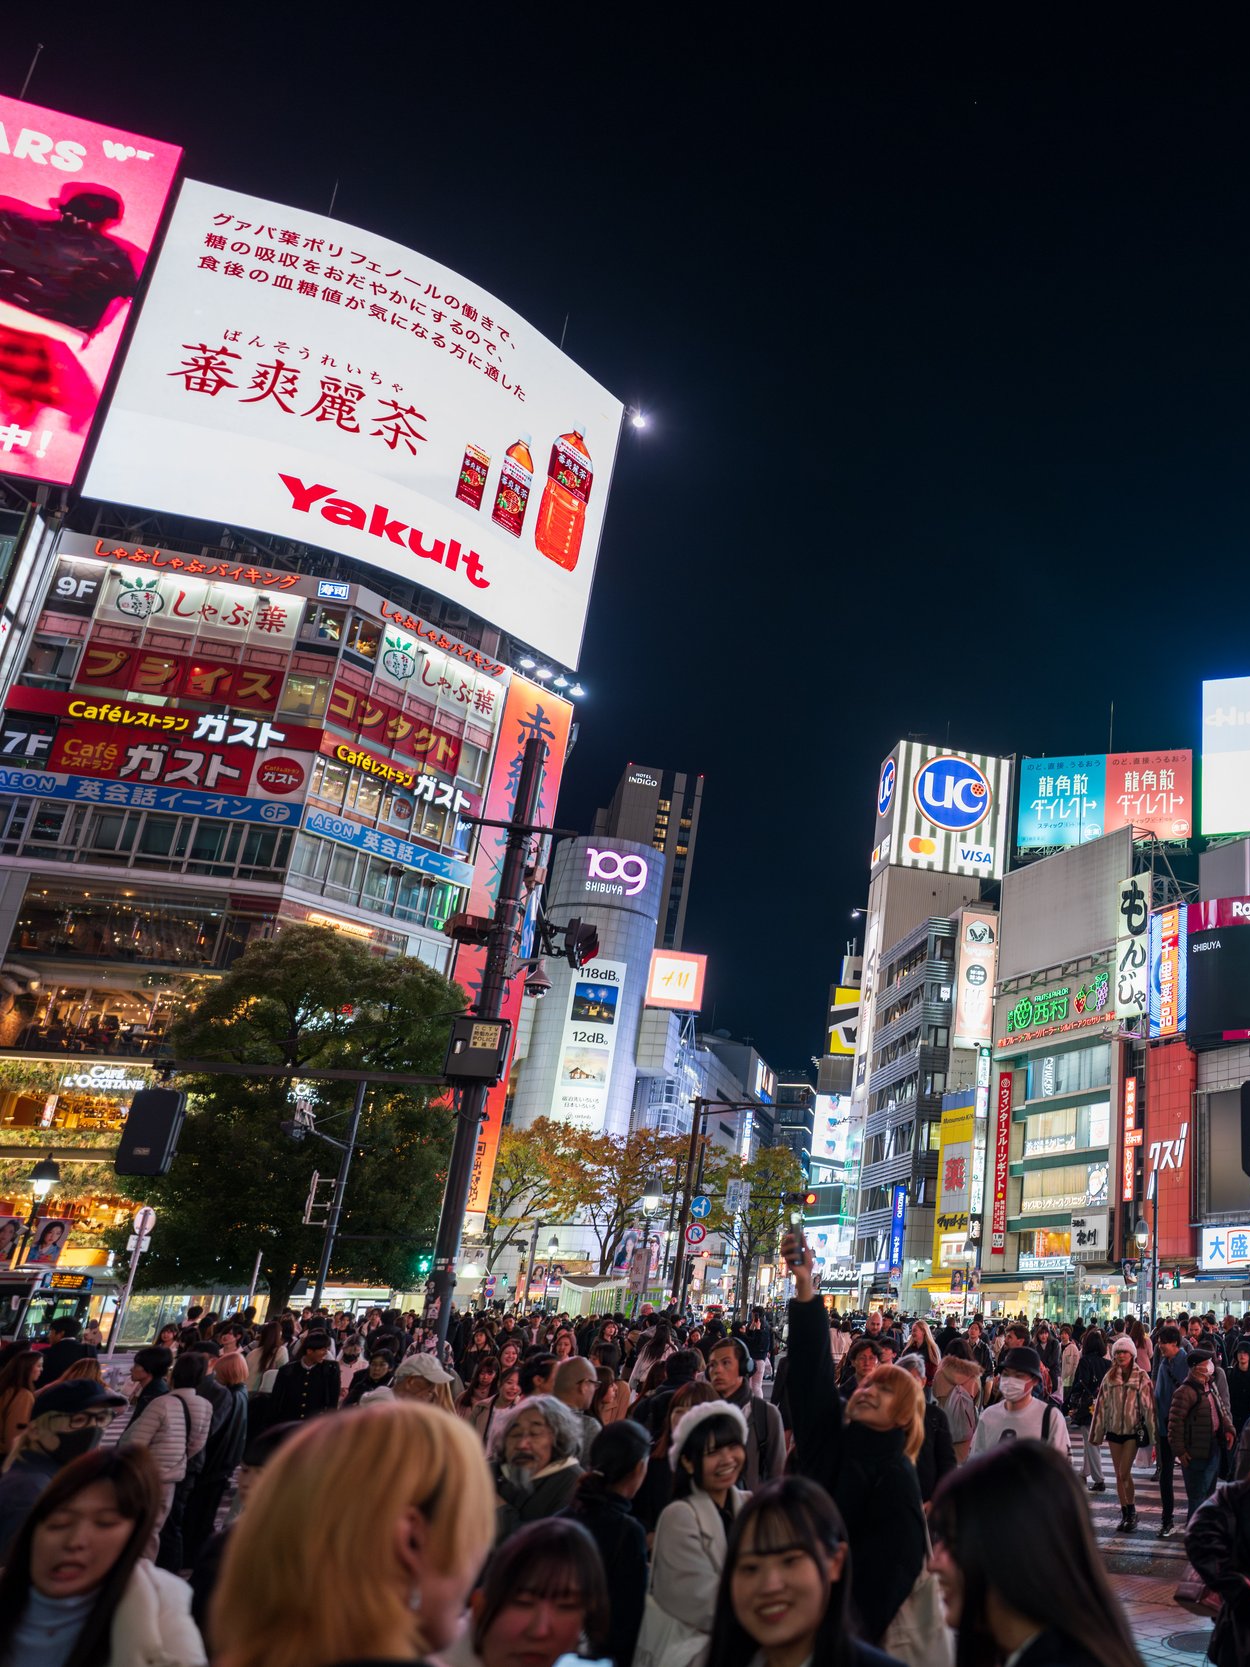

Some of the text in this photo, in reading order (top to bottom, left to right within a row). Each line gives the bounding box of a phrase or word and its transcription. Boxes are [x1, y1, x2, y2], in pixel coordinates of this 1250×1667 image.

[204, 232, 504, 364] 糖の吸収をおだやかにするので、
[212, 211, 517, 350] グァバ葉ポリフェノールの働きで、
[196, 254, 527, 402] 食後の血糖値が気になる方に適した
[223, 327, 405, 394] ばんそうれいちゃ
[167, 342, 429, 456] 蕃爽麗茶
[278, 472, 490, 589] Yakult
[95, 539, 301, 590] しゃぶしゃぶバイキング
[55, 576, 97, 599] 9F
[320, 582, 348, 597] 寿司
[172, 590, 288, 634] しゃぶ葉
[380, 600, 507, 677] しゃぶしゃぶバイキング
[85, 650, 275, 700] プライス
[421, 659, 495, 715] しゃぶ葉
[193, 714, 286, 749] ガスト
[330, 687, 457, 762] コンタクト
[3, 730, 53, 756] 7F
[62, 738, 118, 759] Café
[60, 756, 114, 771] レストラン
[119, 744, 241, 787] ガスト
[263, 771, 299, 785] ガスト
[628, 776, 658, 787] INDIGO
[1124, 768, 1175, 793] 龍角散
[75, 779, 252, 817] 英会話イーオン
[414, 774, 471, 813] ガスト
[1038, 773, 1089, 797] 龍角散
[263, 805, 288, 820] 6F
[1030, 797, 1098, 820] ダイレクト
[1116, 792, 1185, 816] ダイレクト
[312, 813, 355, 840] AEON
[361, 830, 473, 880] 英会話イーオン
[586, 847, 648, 896] 109
[960, 848, 992, 864] VISA
[585, 880, 624, 895] SHIBUYA
[1118, 879, 1149, 1011] もんじゃ
[1192, 940, 1222, 953] SHIBUYA
[1033, 997, 1069, 1026] 西村
[472, 1035, 498, 1043] POLICE
[997, 1089, 1010, 1191] ウィンターフルーツギフト
[945, 1156, 967, 1192] 薬
